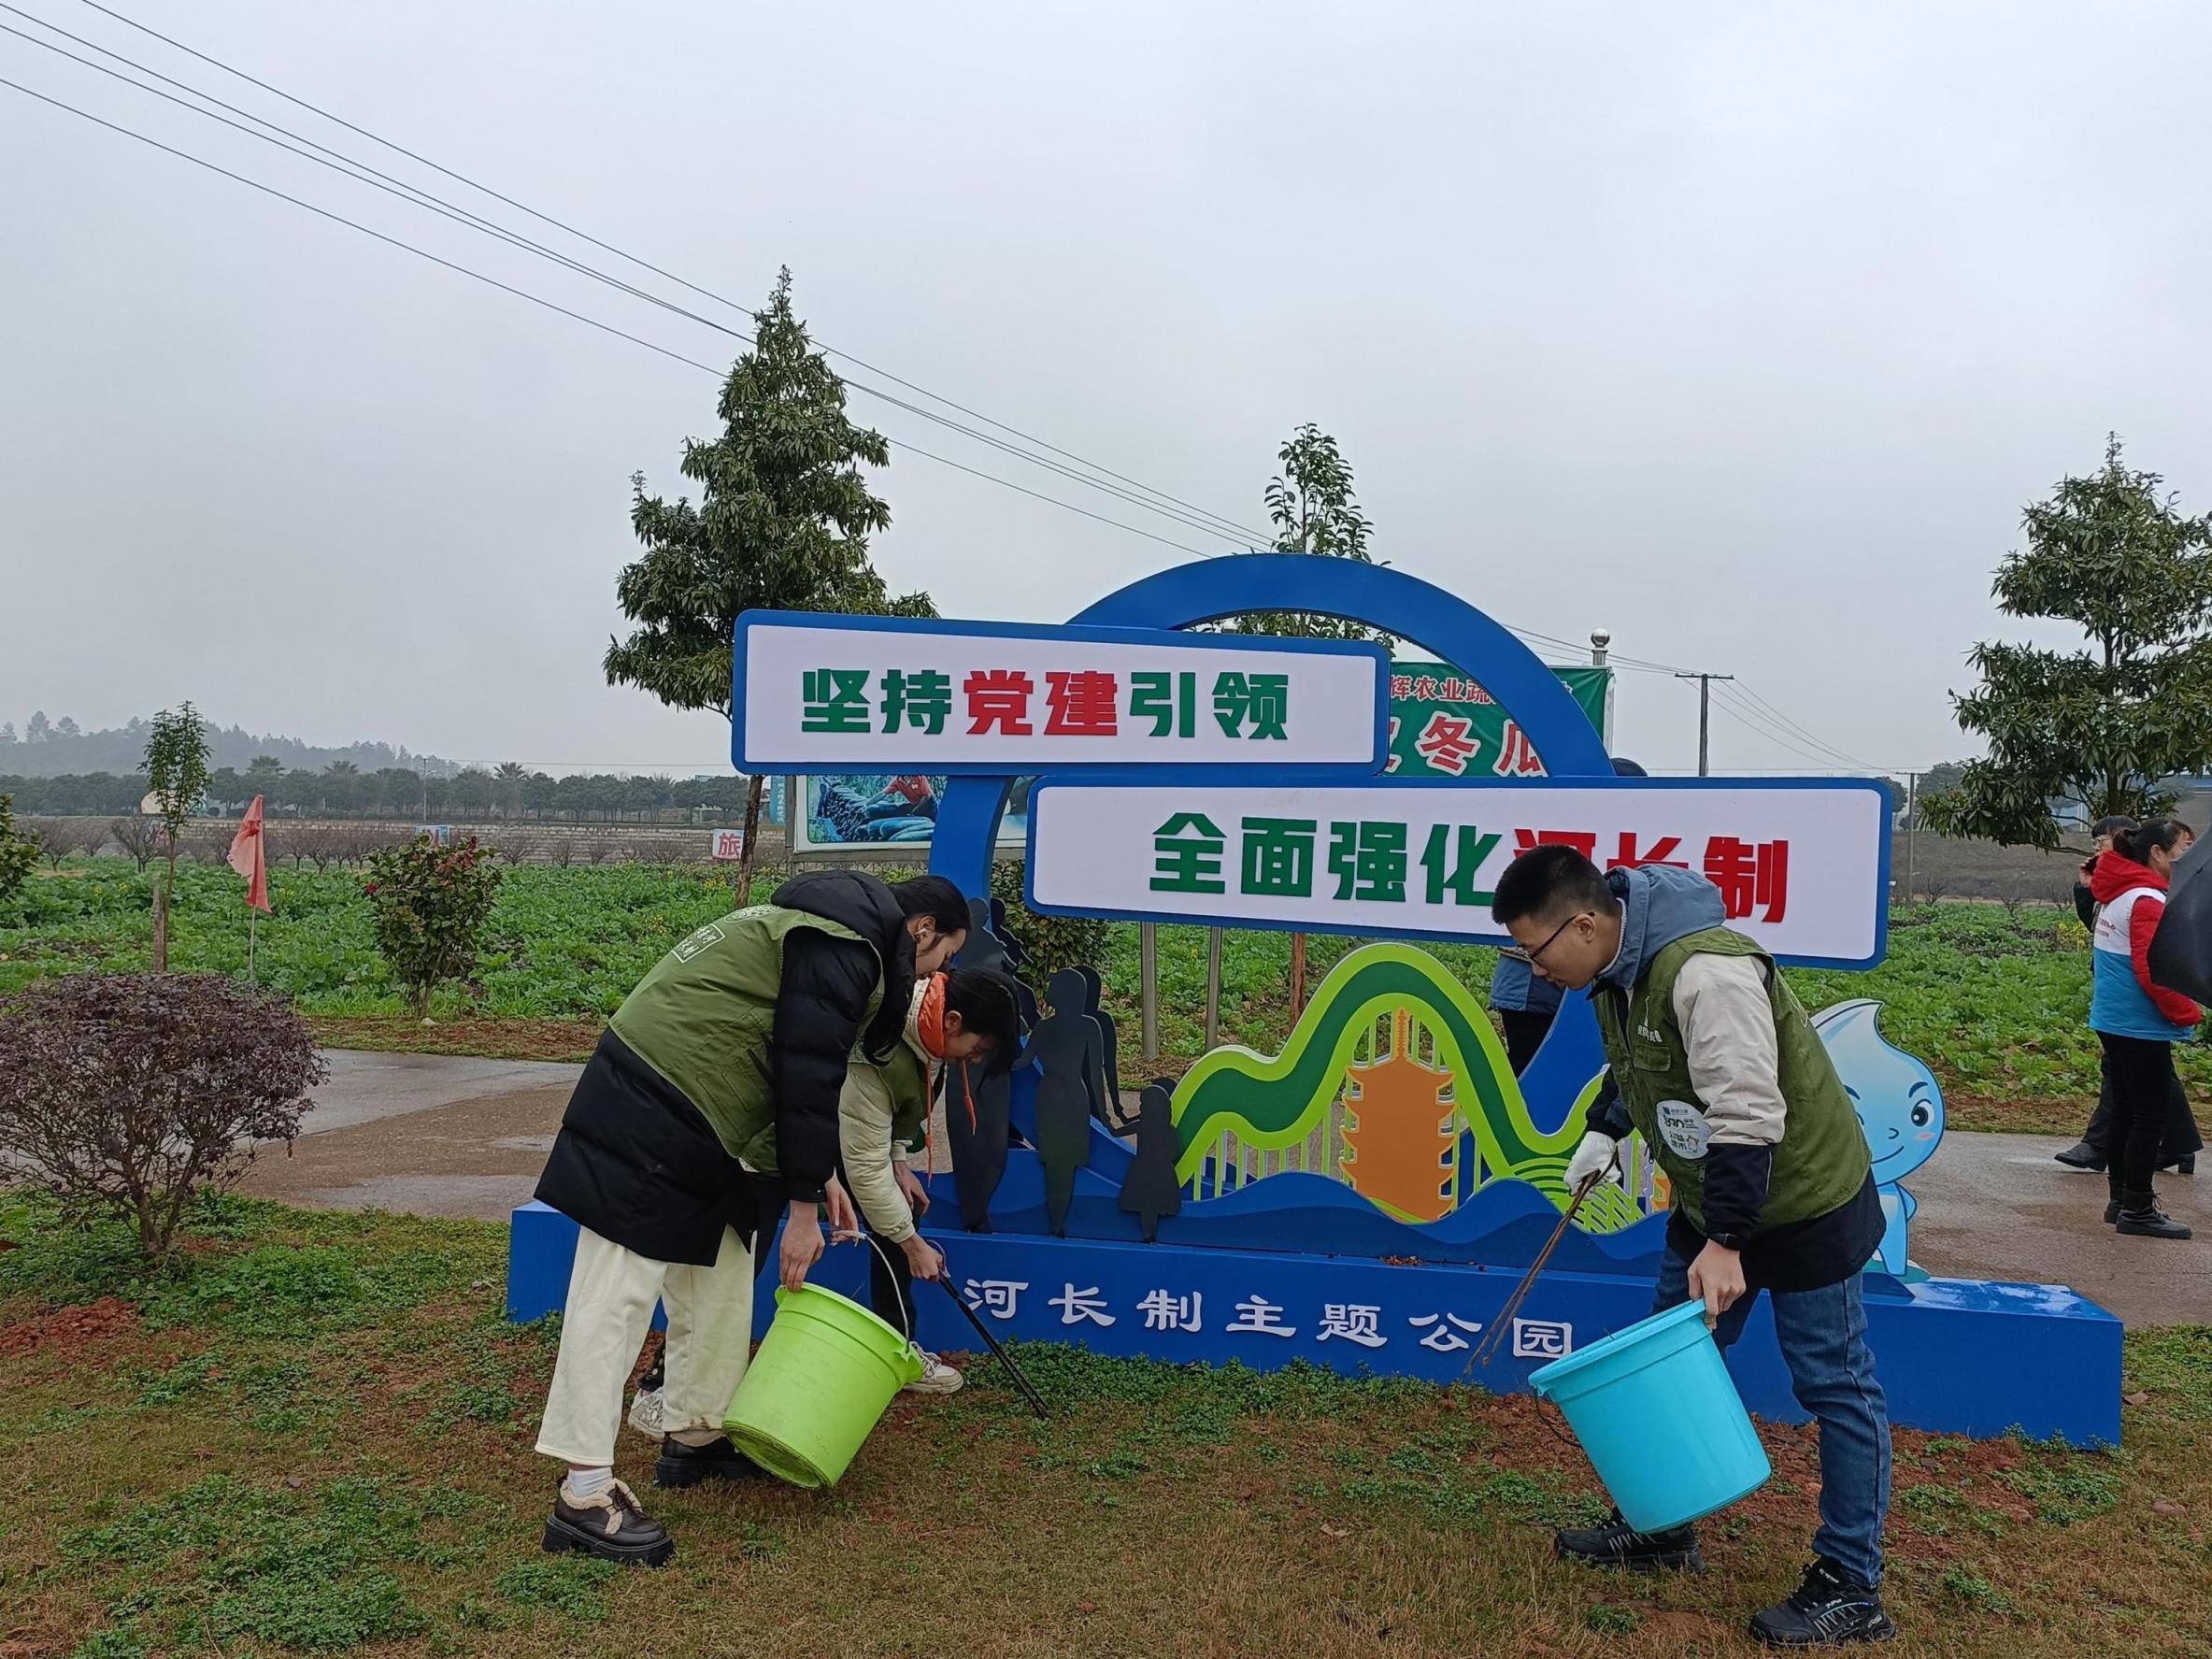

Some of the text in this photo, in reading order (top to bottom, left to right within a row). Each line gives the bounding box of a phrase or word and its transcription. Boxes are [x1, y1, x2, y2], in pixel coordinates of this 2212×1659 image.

[802, 668, 1289, 740] 坚持党建引领
[1391, 674, 1496, 704] 辉农业蔬
[1389, 713, 1543, 774] 冬瓜
[718, 832, 741, 855] 旅
[963, 1280, 1574, 1359] 河长制主题公园
